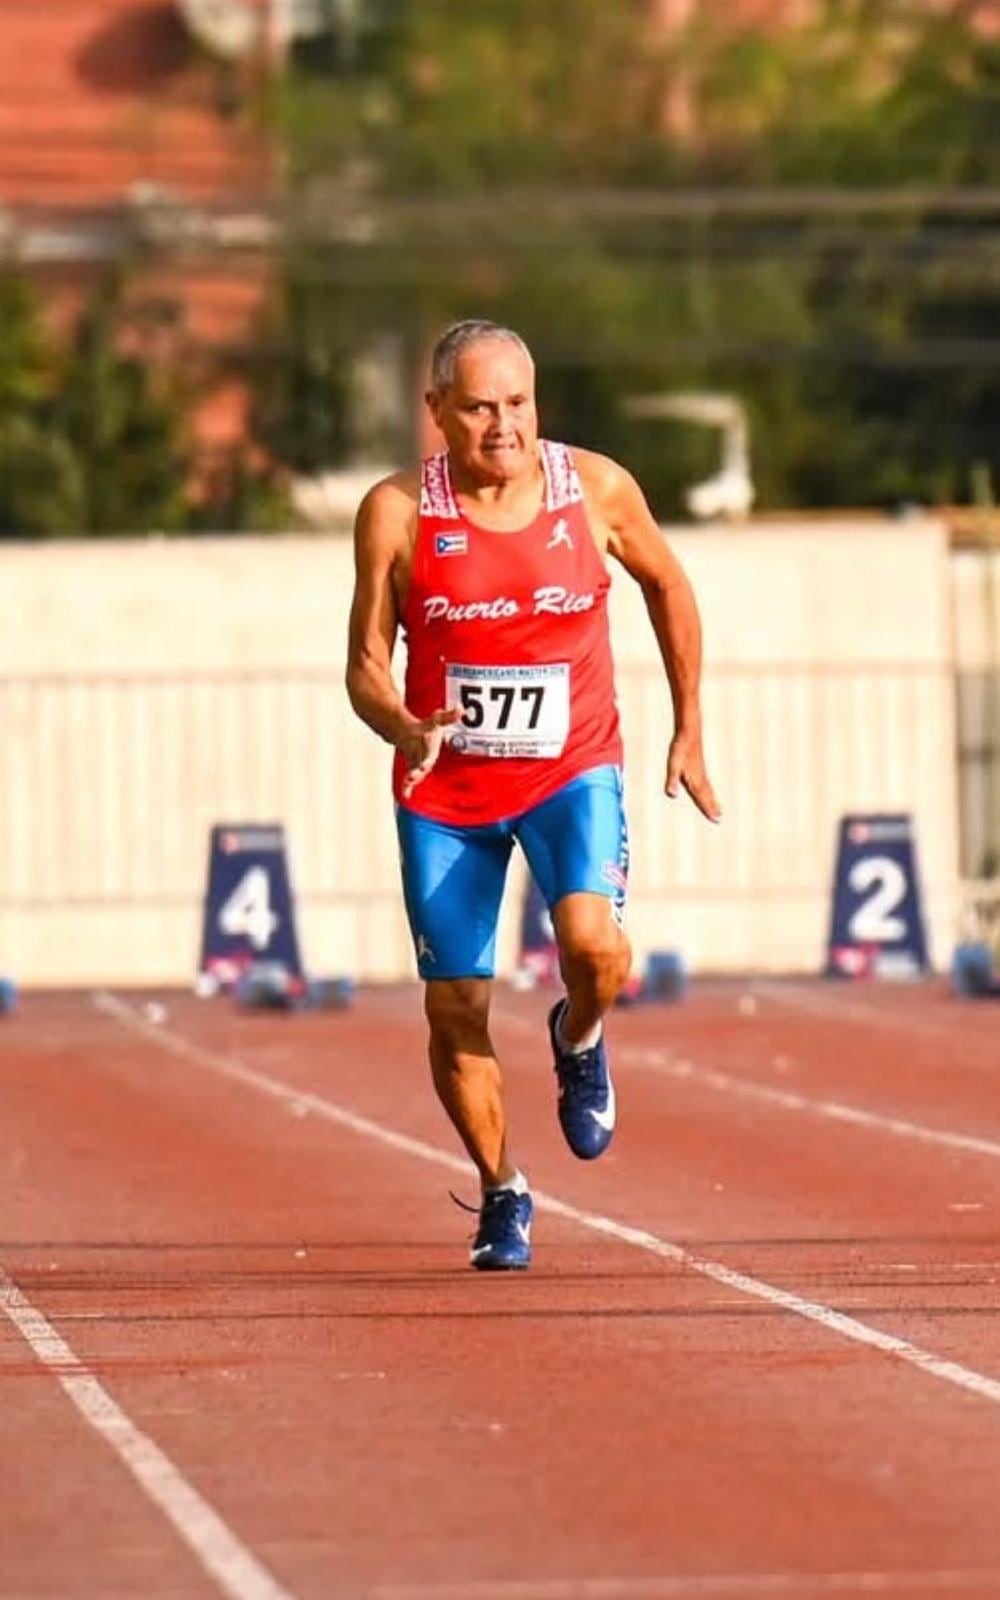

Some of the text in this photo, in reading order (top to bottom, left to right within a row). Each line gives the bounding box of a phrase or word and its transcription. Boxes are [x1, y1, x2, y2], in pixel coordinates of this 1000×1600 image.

[423, 586, 594, 624] Puerto Rico
[460, 685, 545, 730] 577
[219, 865, 279, 950] 4
[849, 855, 907, 941] 2
